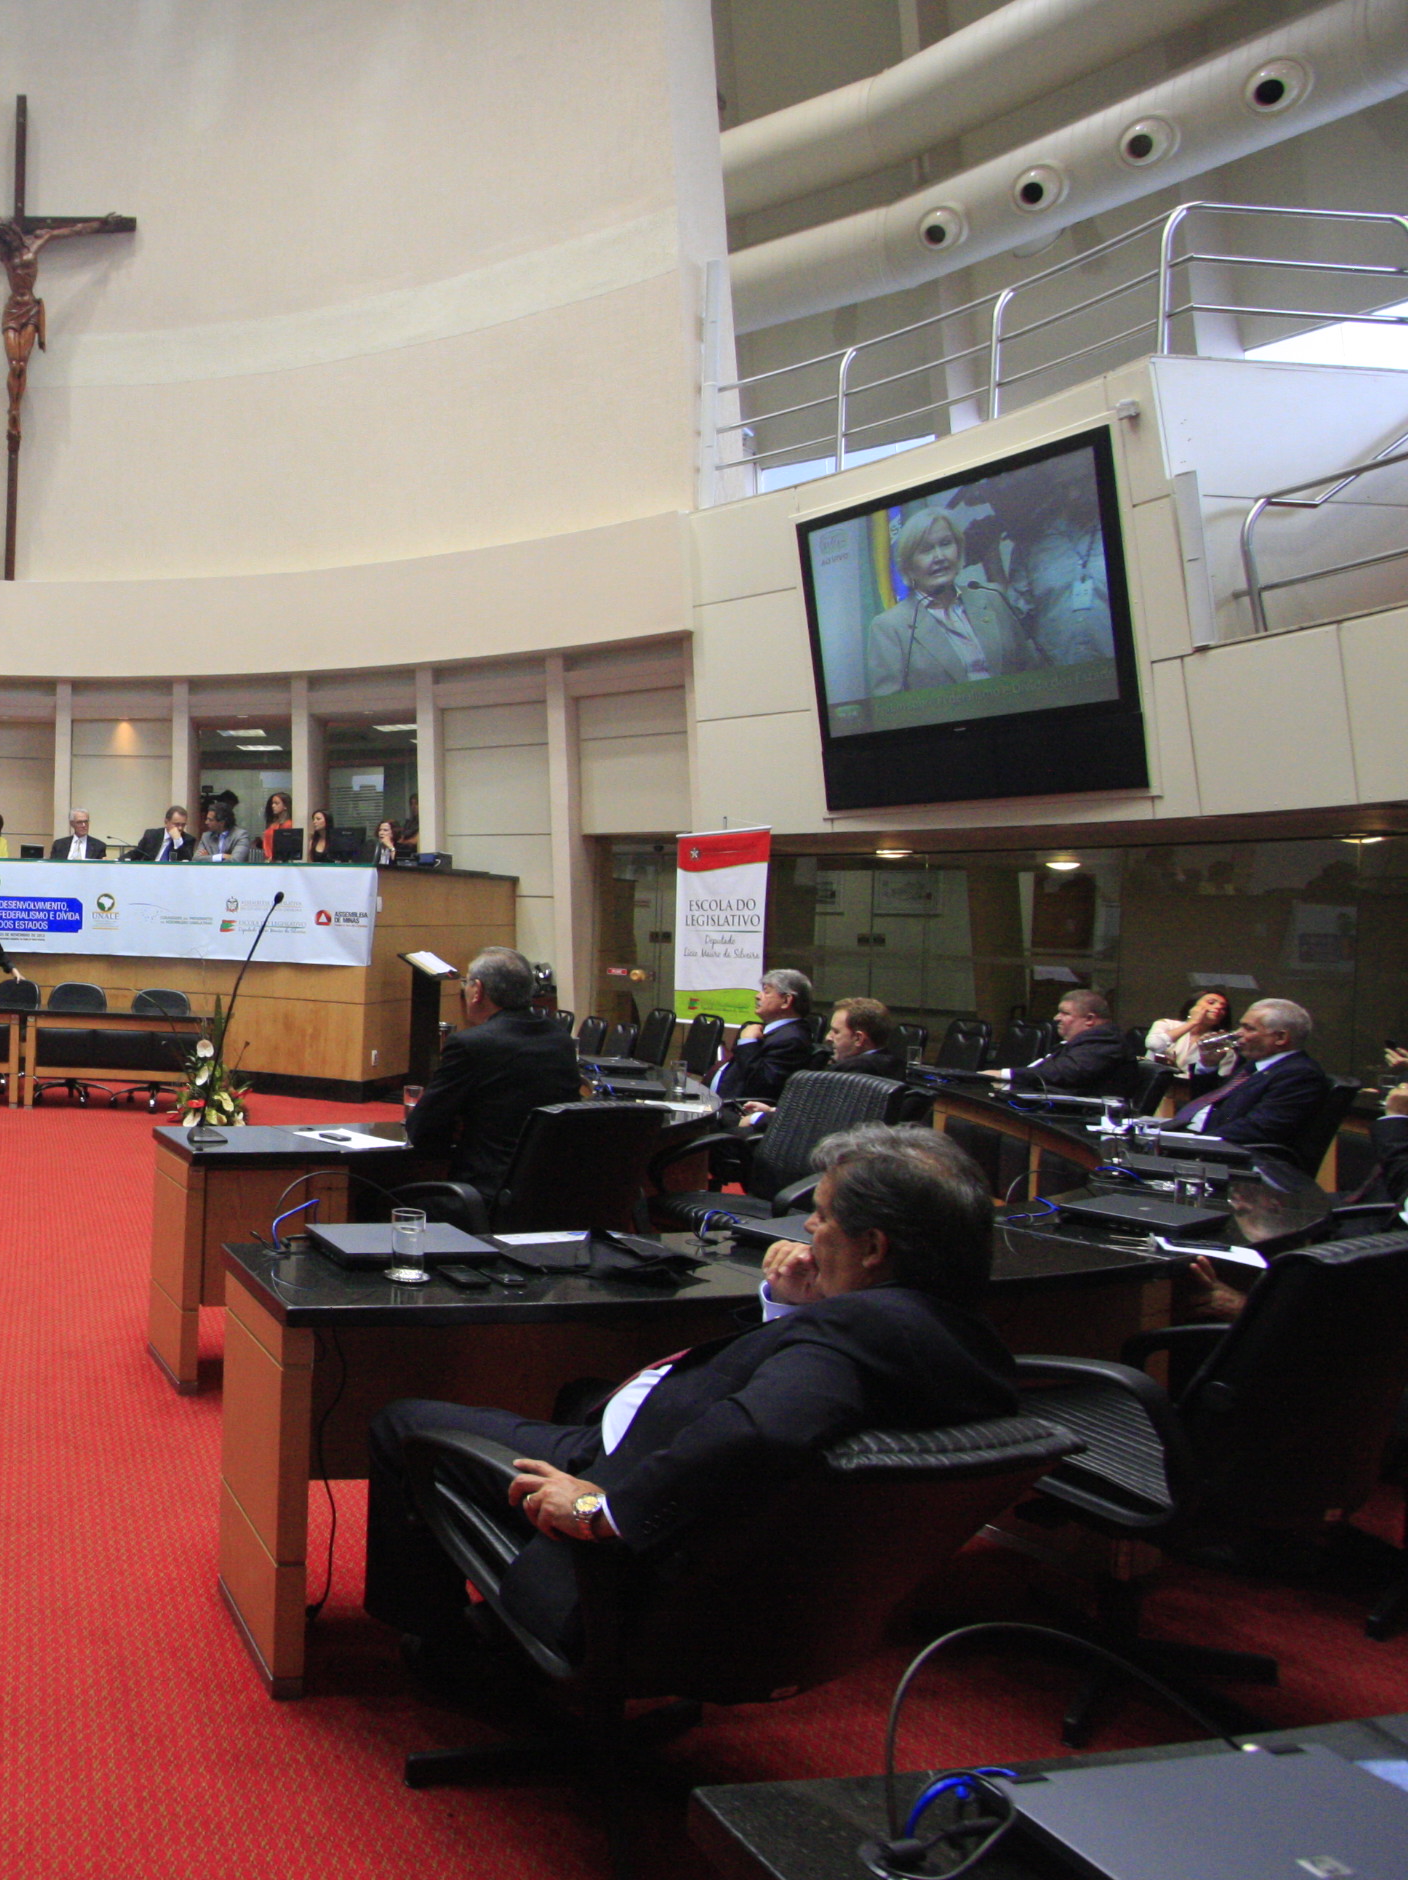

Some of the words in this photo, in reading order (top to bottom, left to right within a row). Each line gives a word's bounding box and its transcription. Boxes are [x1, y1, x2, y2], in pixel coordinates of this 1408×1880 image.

[689, 899, 734, 912] ESCOLA
[736, 898, 757, 911] DO
[49, 912, 55, 920] E
[56, 911, 80, 920] DÍVIDA
[685, 914, 761, 927] LEGISLATIVO
[15, 921, 49, 930] ESTADOS
